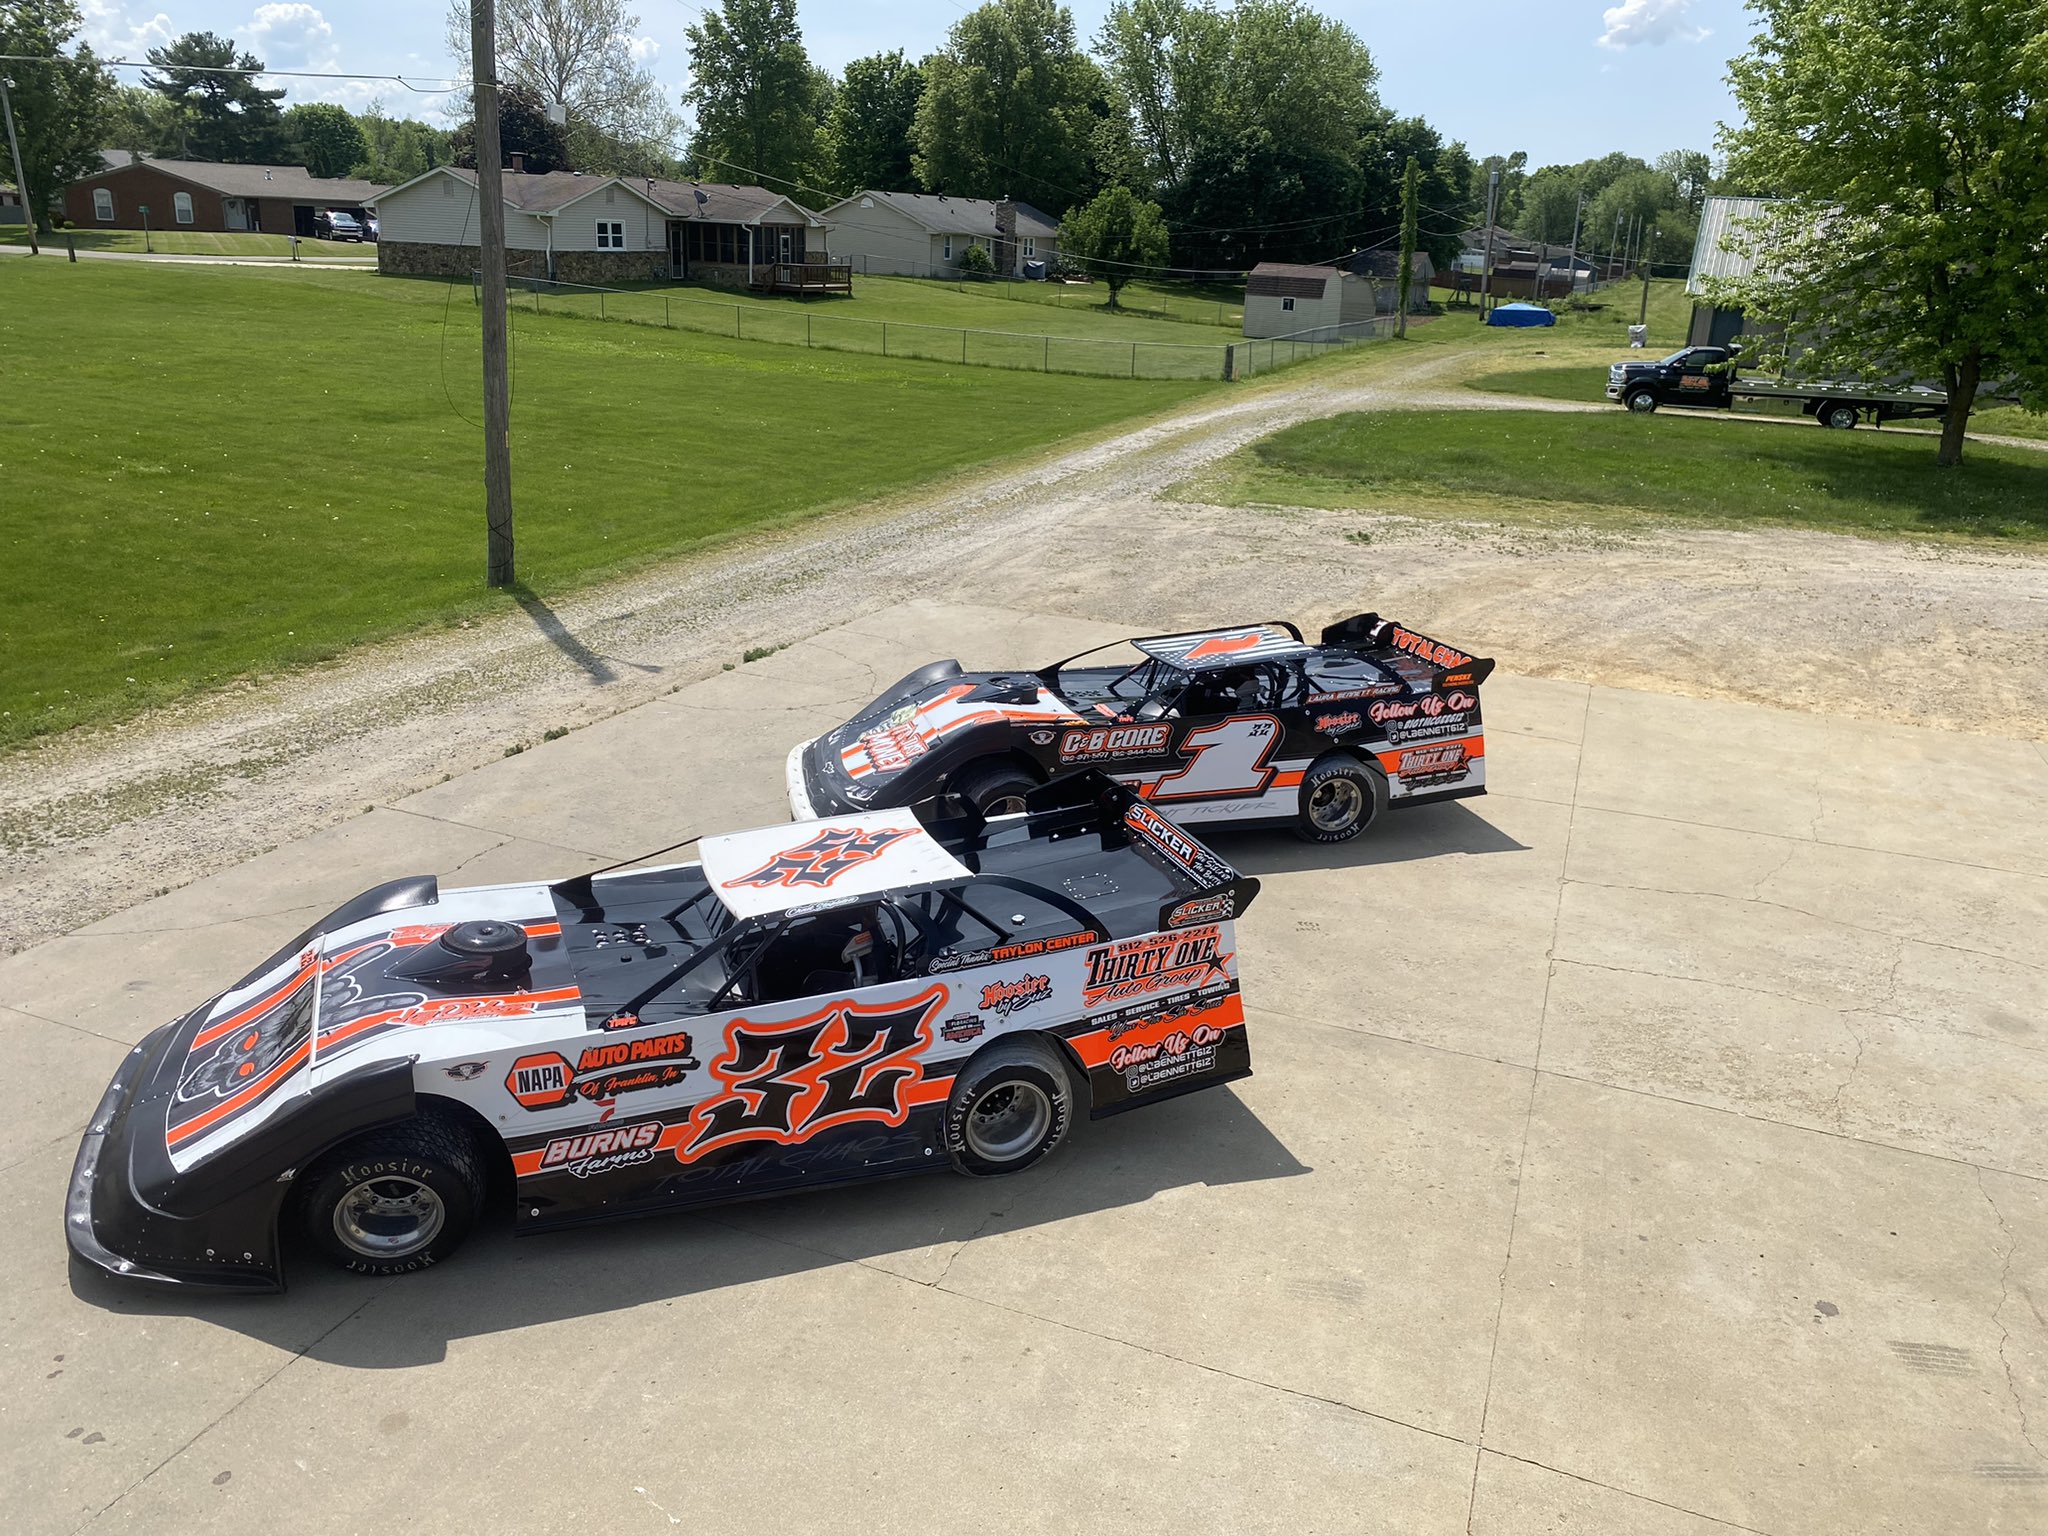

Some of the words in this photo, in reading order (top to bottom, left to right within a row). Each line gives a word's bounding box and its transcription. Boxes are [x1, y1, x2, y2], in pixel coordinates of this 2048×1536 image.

[1391, 627, 1434, 661] TOTAL
[1432, 645, 1472, 670] CHA
[1370, 702, 1418, 722] Follow
[1420, 695, 1445, 716] Us
[1448, 692, 1475, 711] On
[1107, 726, 1168, 749] CORE
[1148, 714, 1281, 800] 1
[1310, 767, 1354, 788] Hoosier
[1130, 806, 1194, 860] SLICKER
[1173, 901, 1221, 917] SLICKER
[991, 941, 1043, 960] TAYLON
[1046, 932, 1095, 950] CENTER
[1087, 946, 1171, 987] THIRTY
[1174, 936, 1216, 966] ONE
[980, 974, 1051, 1009] Hoosier
[1088, 983, 1142, 1005] Auto
[1145, 968, 1202, 991] Group
[997, 999, 1011, 1015] by
[1091, 1013, 1118, 1026] SALES
[1125, 1001, 1160, 1017] SERVICE
[1167, 993, 1190, 1005] TIRES
[1197, 982, 1230, 997] TOWING
[578, 1046, 629, 1071] AUTO
[630, 1033, 687, 1061] PARTS
[1112, 1044, 1161, 1069] Follow
[1164, 1032, 1190, 1054] Us
[1192, 1026, 1221, 1045] On
[517, 1065, 565, 1094] NAPA
[580, 1081, 600, 1096] Of
[950, 1088, 976, 1153] Hoosier
[543, 1122, 660, 1165] BURNS
[341, 1158, 432, 1187] Hoosier
[569, 1149, 650, 1175] Farms
[346, 1251, 436, 1274] Hoosier
